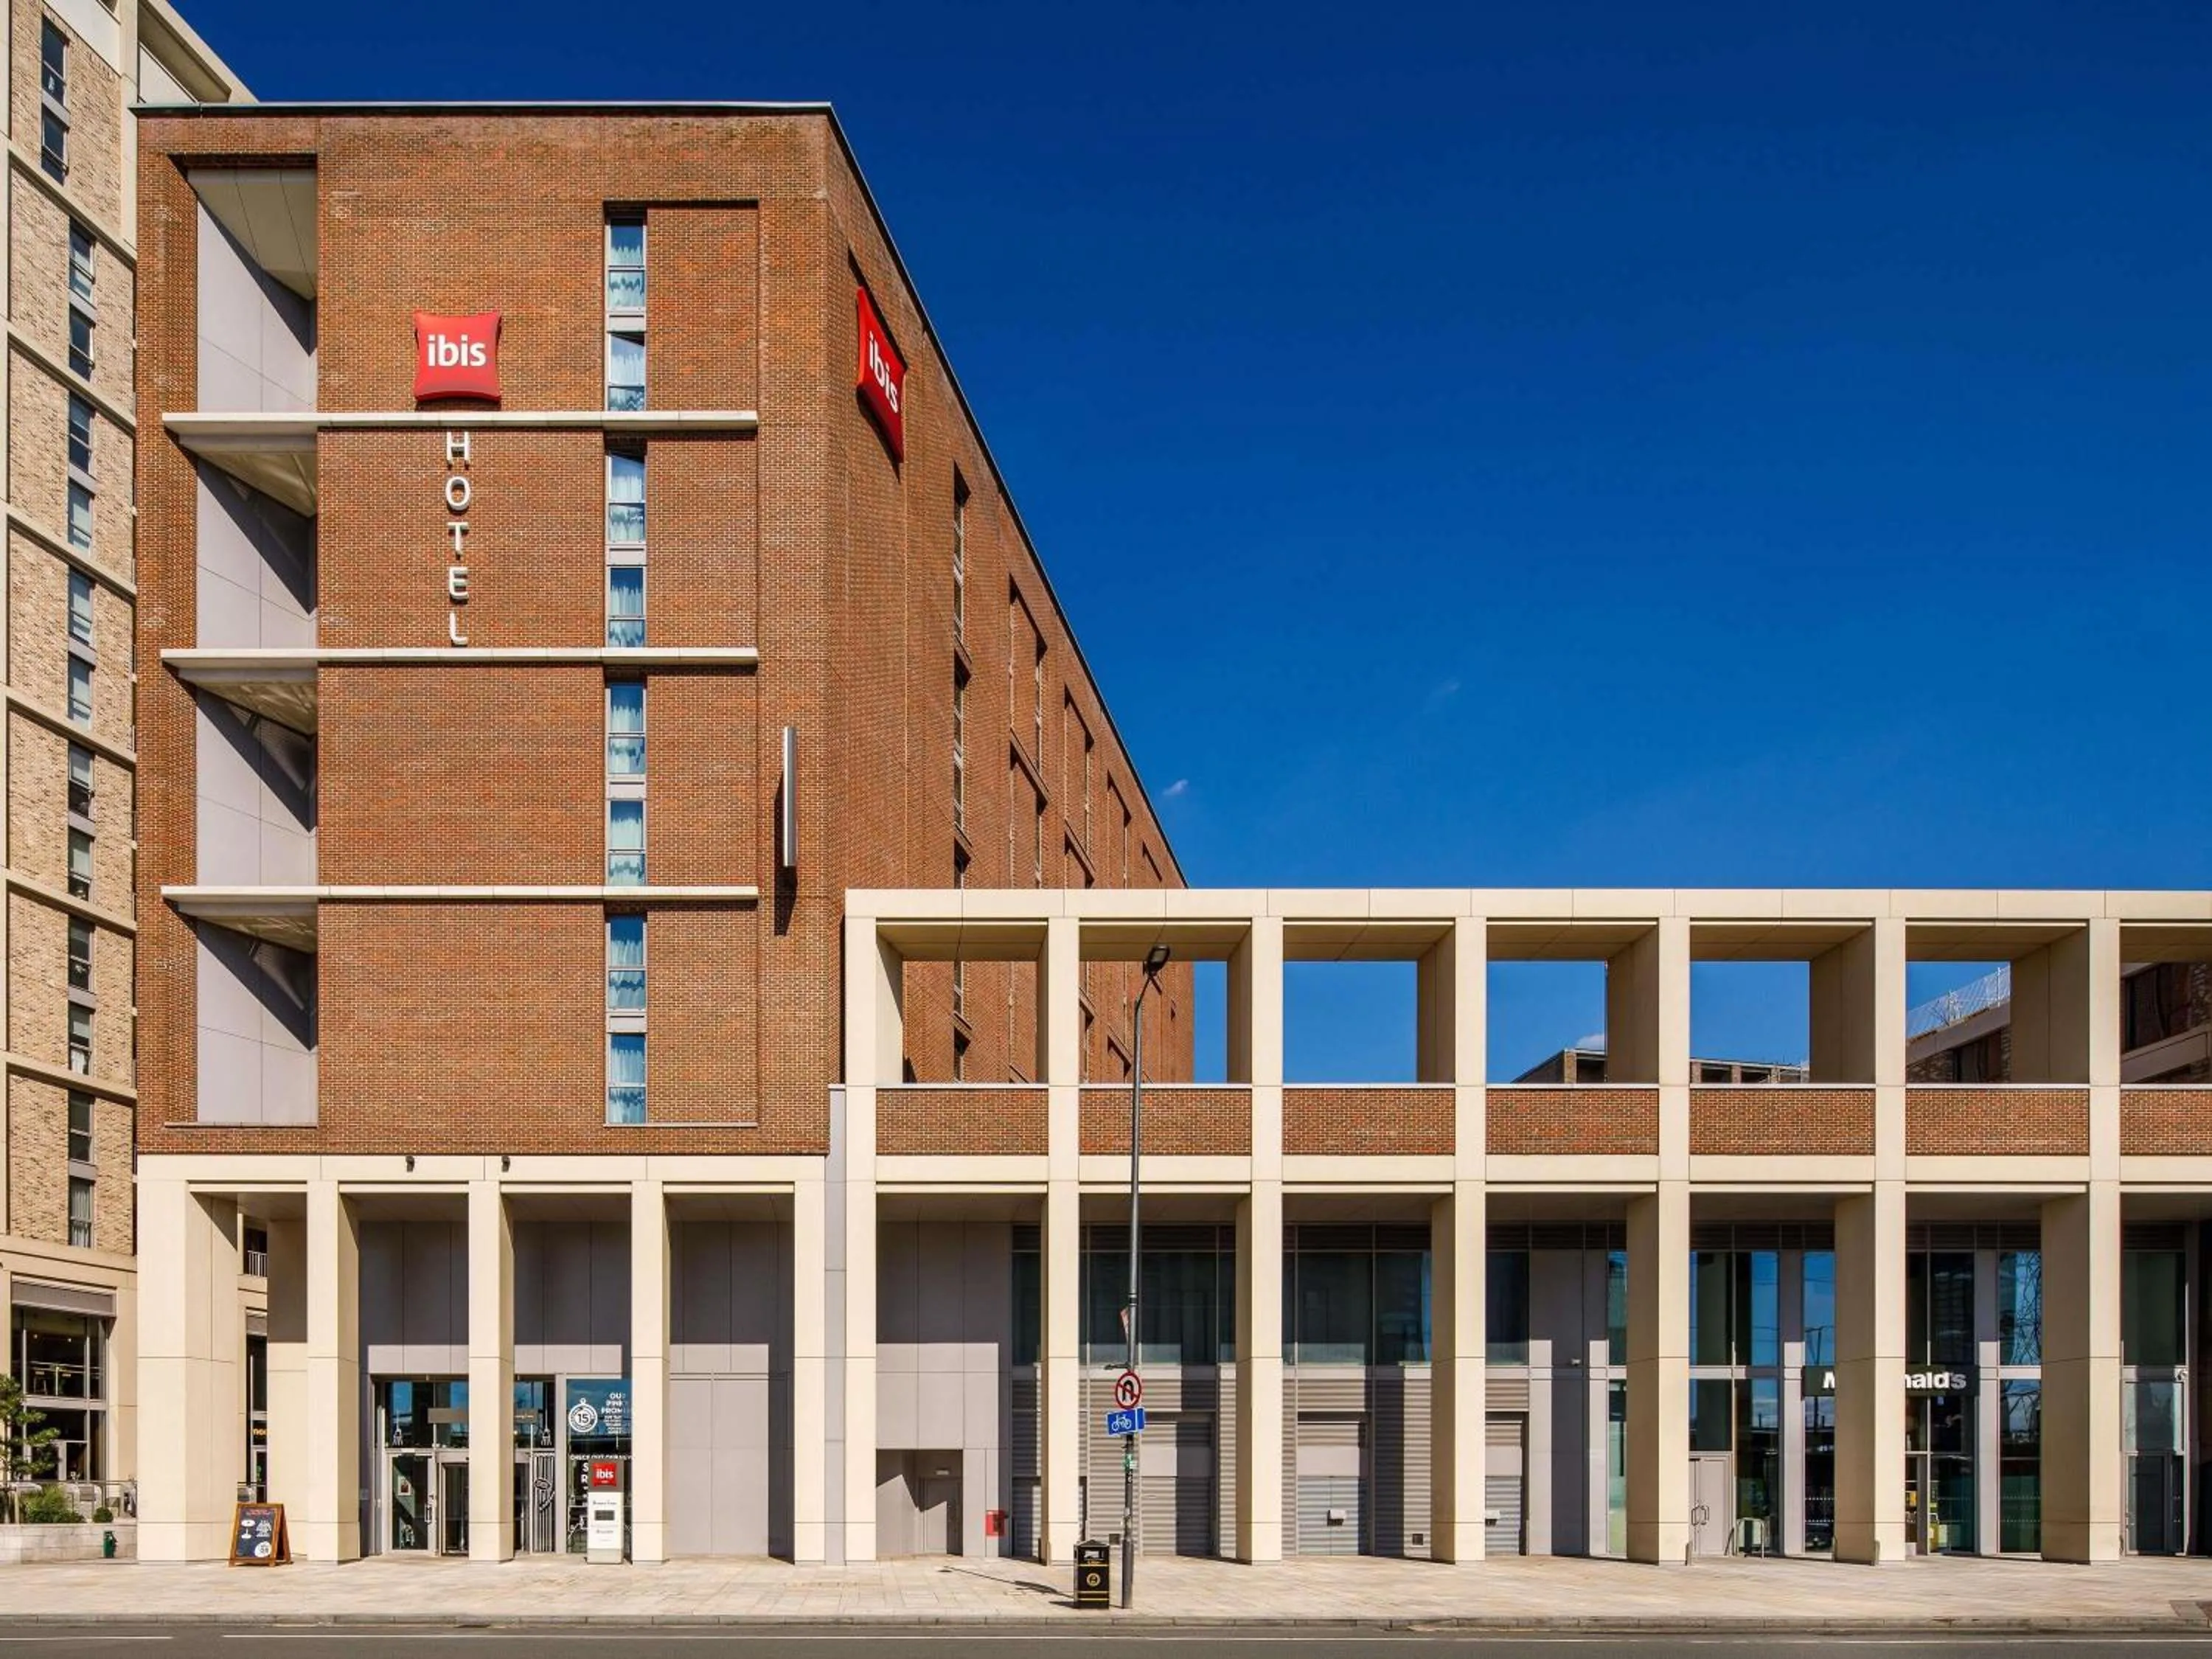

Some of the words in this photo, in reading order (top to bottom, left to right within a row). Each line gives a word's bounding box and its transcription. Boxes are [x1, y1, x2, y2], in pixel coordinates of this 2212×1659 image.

[428, 334, 487, 366] ibis
[869, 330, 898, 413] ibis
[445, 431, 470, 645] HOTEL
[578, 1413, 589, 1424] 15
[596, 1469, 614, 1480] ibis
